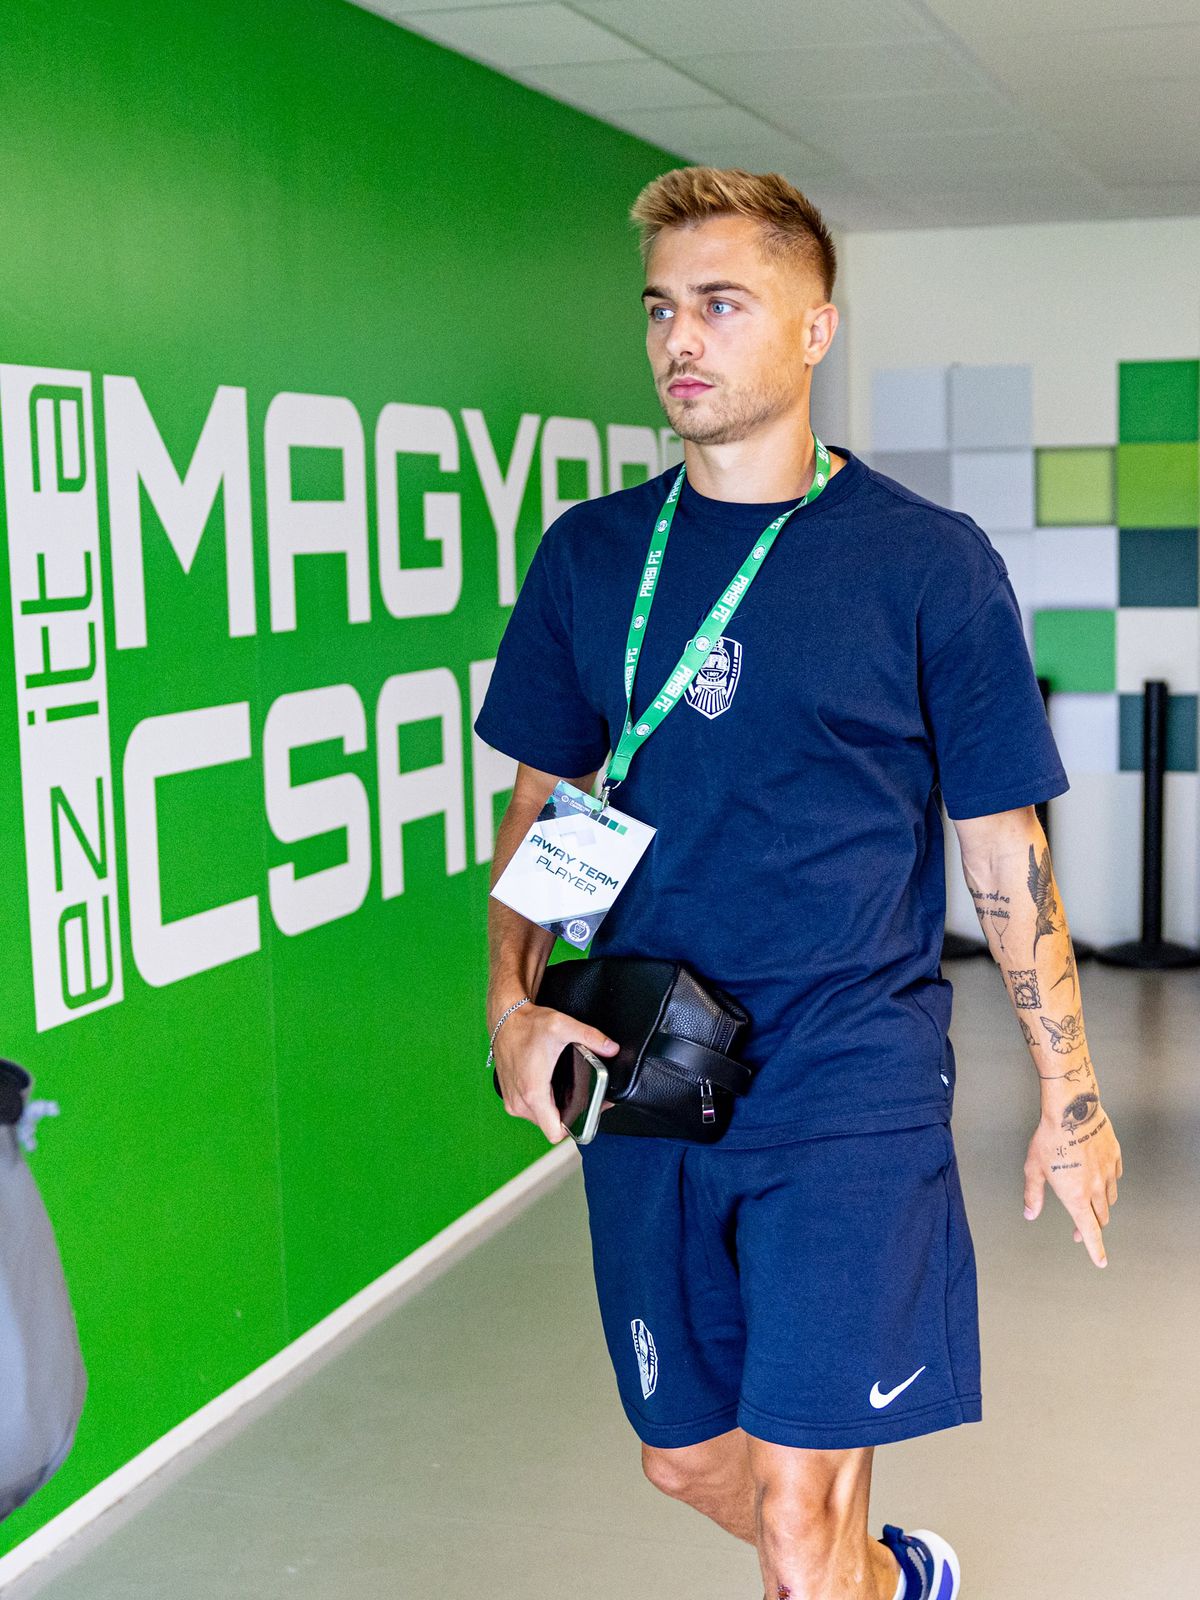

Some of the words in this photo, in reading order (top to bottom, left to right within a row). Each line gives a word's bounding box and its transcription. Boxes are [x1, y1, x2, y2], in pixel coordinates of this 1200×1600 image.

[29, 384, 86, 492] a
[103, 374, 684, 650] MAGYA
[647, 550, 662, 565] FC
[21, 551, 100, 726] itt
[711, 604, 731, 623] FC
[653, 694, 674, 713] FC
[530, 834, 577, 865] AWAY
[579, 861, 619, 890] TEAM
[536, 855, 597, 895] PLAYER
[50, 777, 113, 1010] ez
